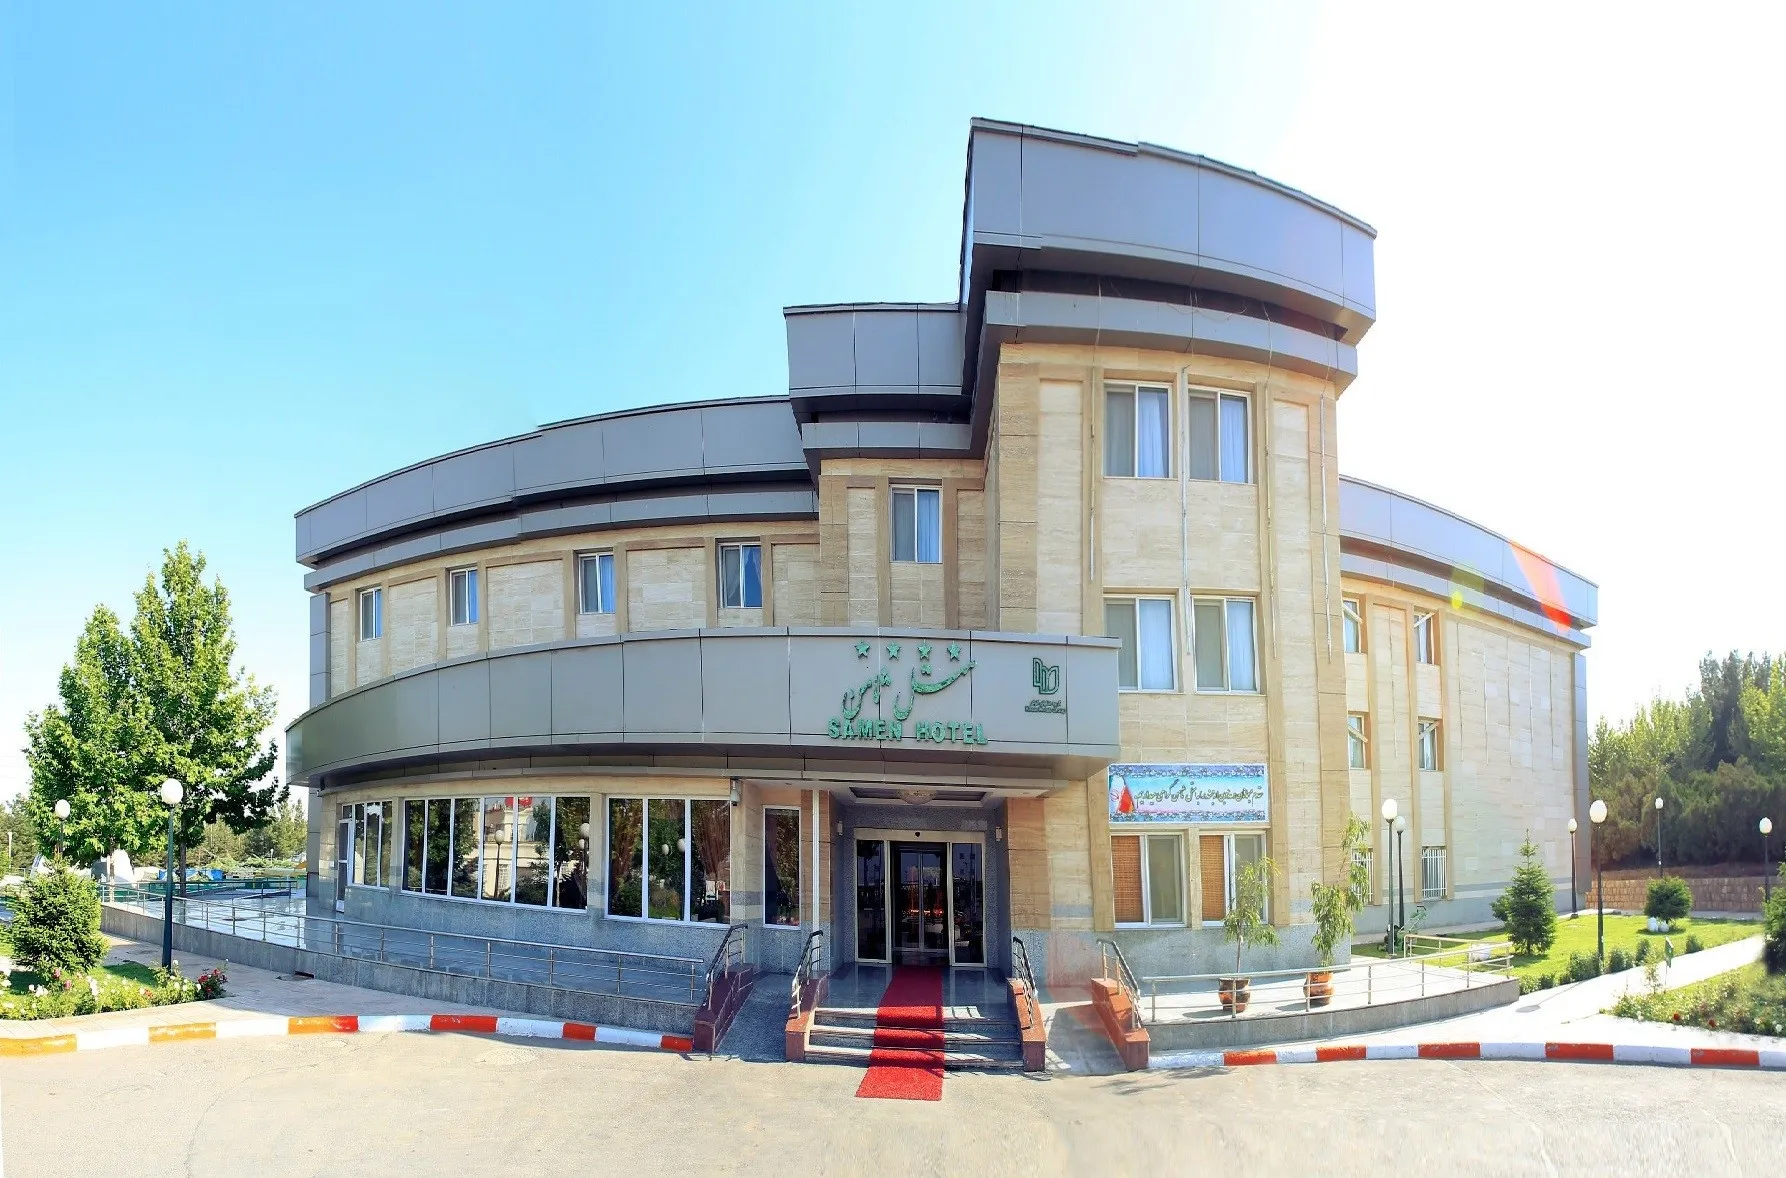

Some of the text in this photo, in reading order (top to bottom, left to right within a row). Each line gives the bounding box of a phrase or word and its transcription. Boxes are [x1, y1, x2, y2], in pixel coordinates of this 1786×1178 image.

[842, 661, 977, 720] هتل ثامن
[828, 717, 988, 745] SAMEN HOTEL
